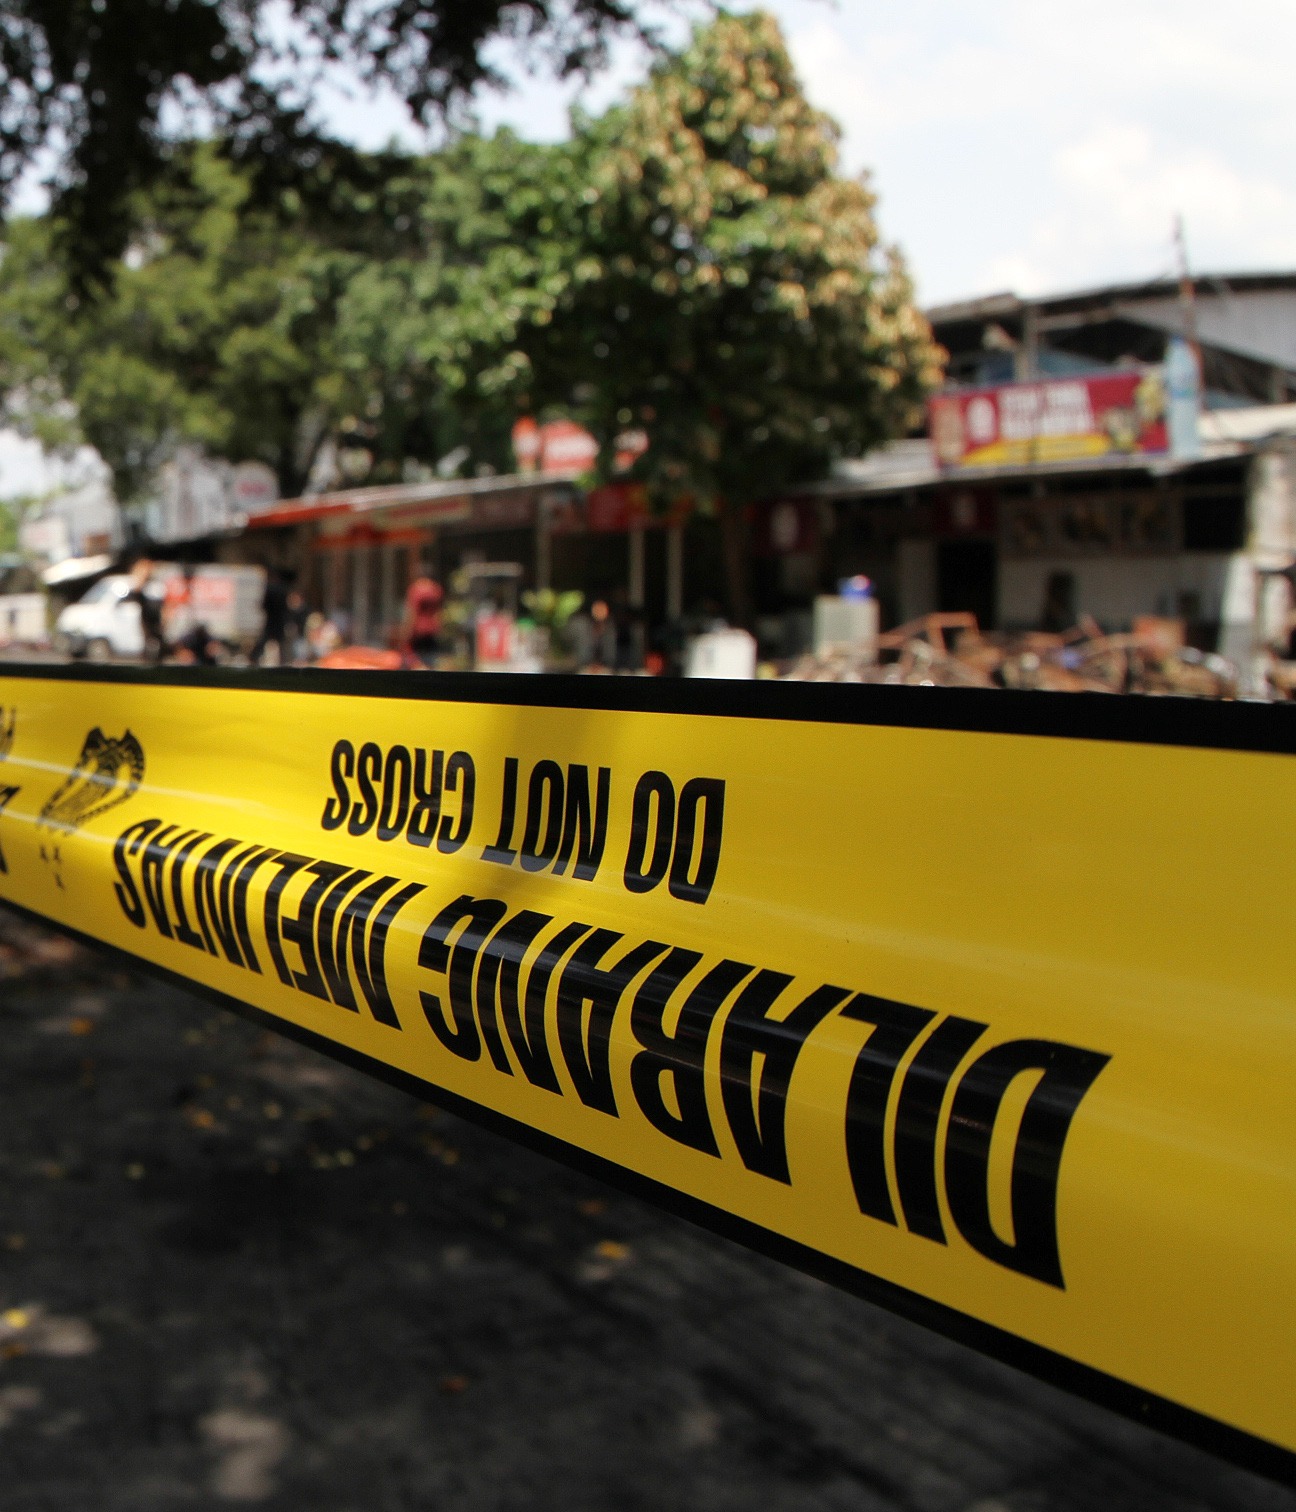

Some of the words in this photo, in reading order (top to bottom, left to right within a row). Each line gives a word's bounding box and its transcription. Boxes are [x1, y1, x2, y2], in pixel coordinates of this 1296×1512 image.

[320, 739, 476, 856] CROSS
[480, 756, 612, 882] NOT
[623, 769, 727, 905] DO
[112, 818, 428, 1031] MELINTAS
[417, 894, 1113, 1291] DILARANG
